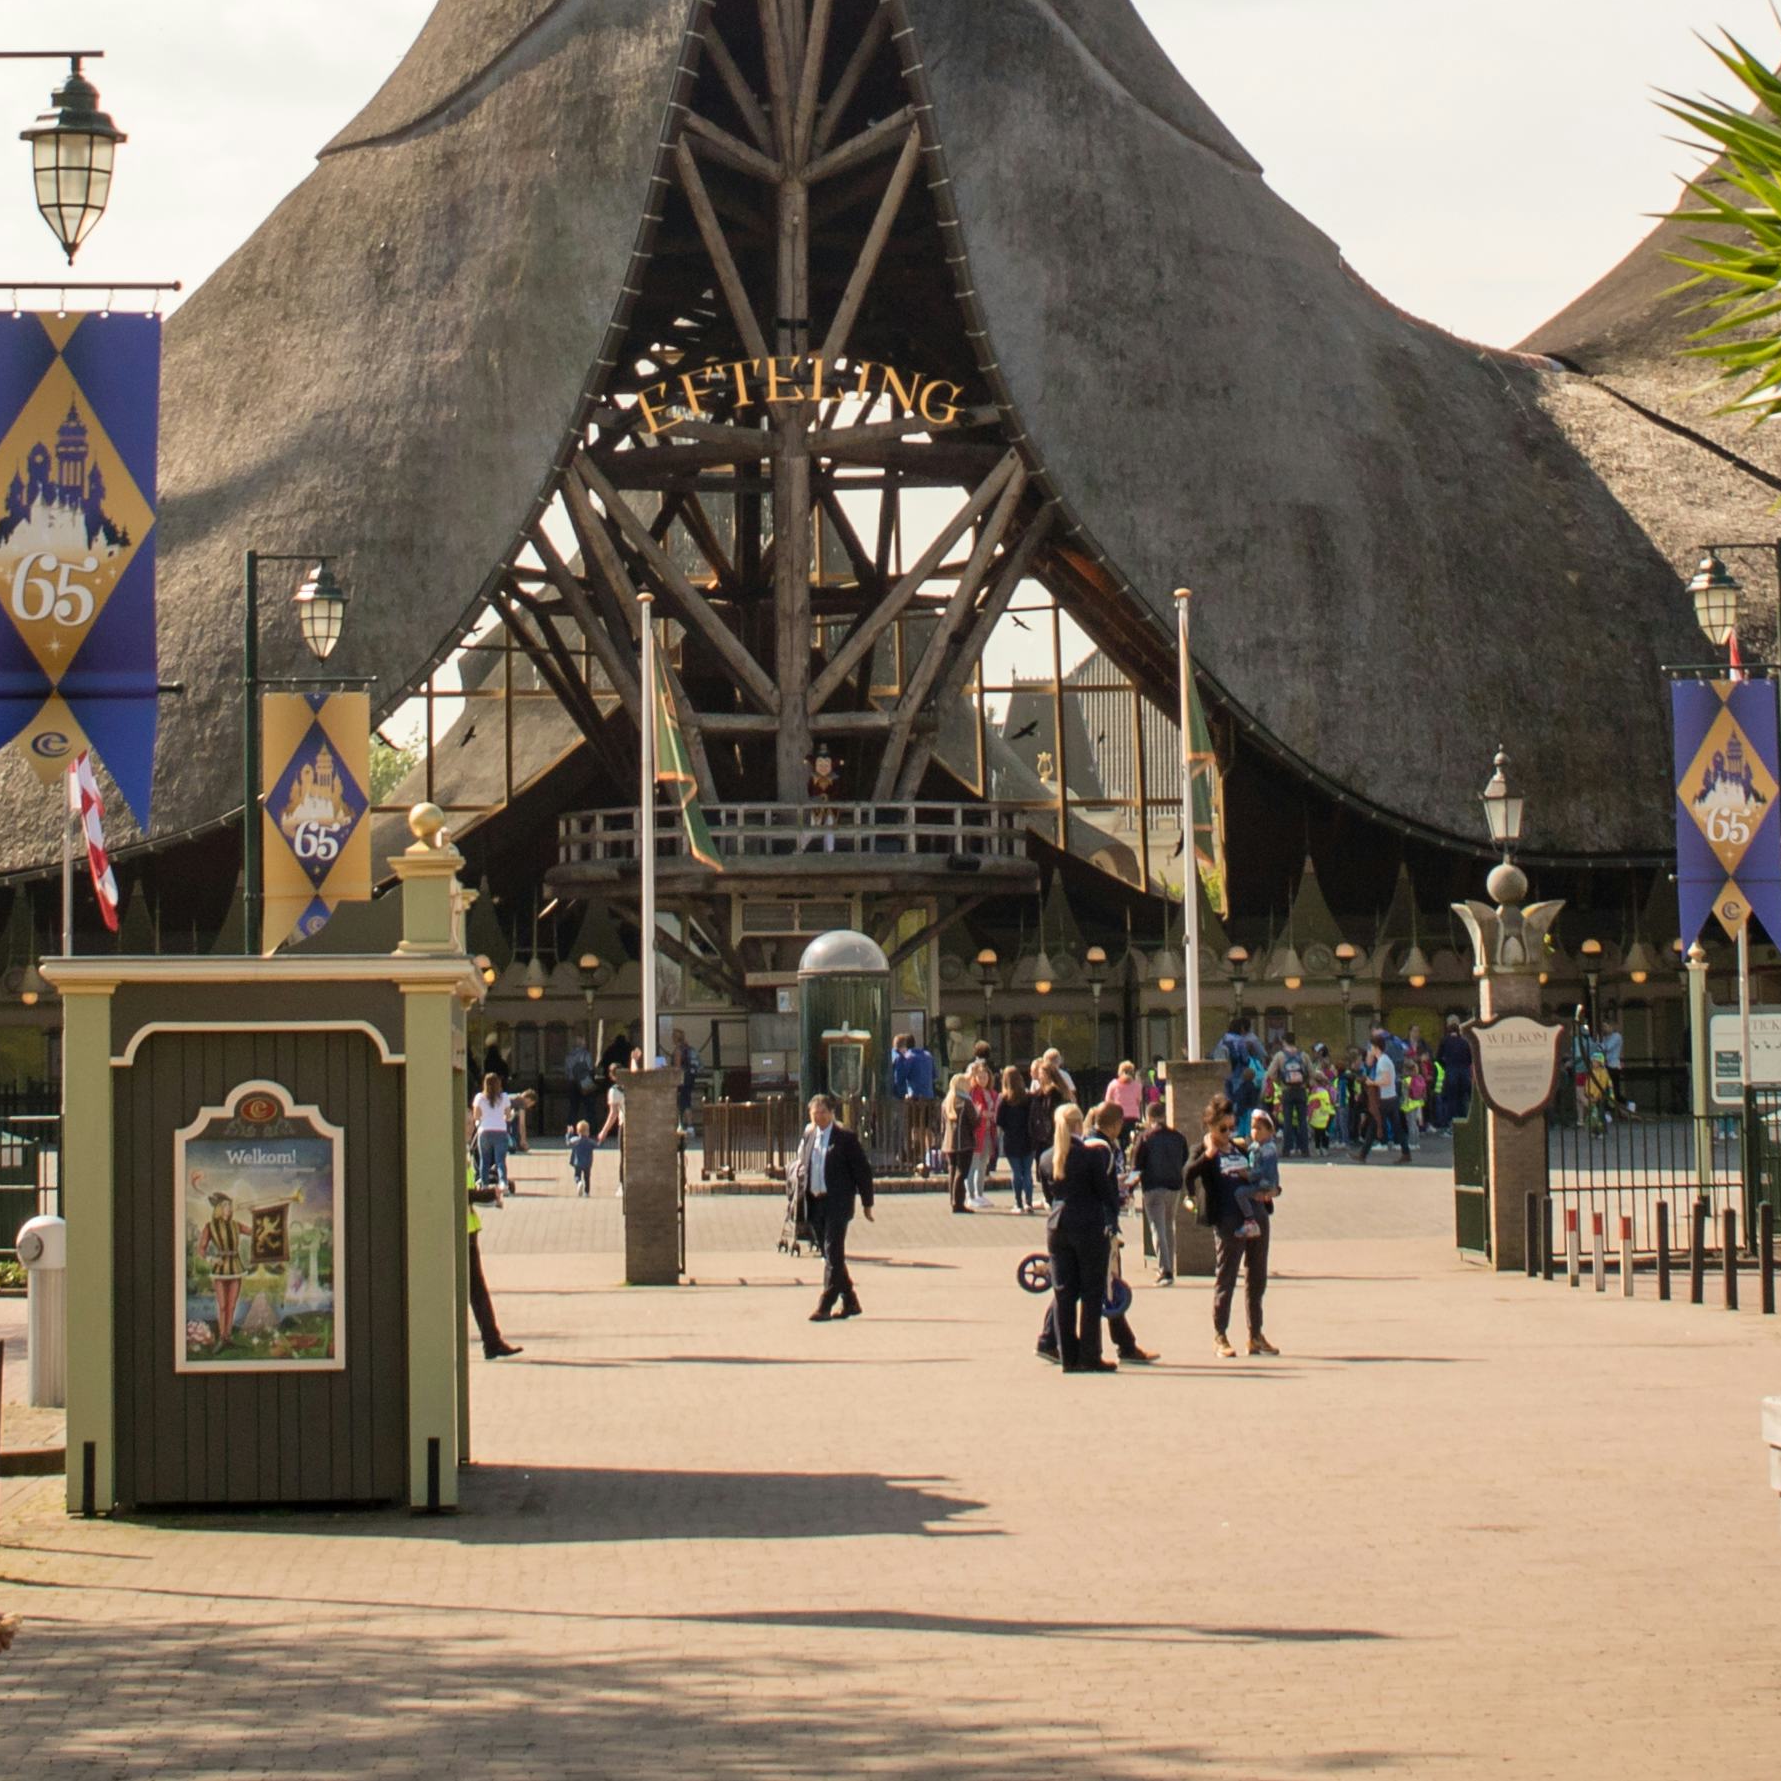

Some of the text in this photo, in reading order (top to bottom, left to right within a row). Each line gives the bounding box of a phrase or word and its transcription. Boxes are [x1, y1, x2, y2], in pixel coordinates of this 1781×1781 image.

[636, 356, 966, 434] EFTELING
[11, 551, 99, 627] 65
[294, 820, 340, 860] 65
[1707, 806, 1751, 845] 65
[1486, 1031, 1548, 1045] WELKOM
[226, 1149, 296, 1165] Welkom!
